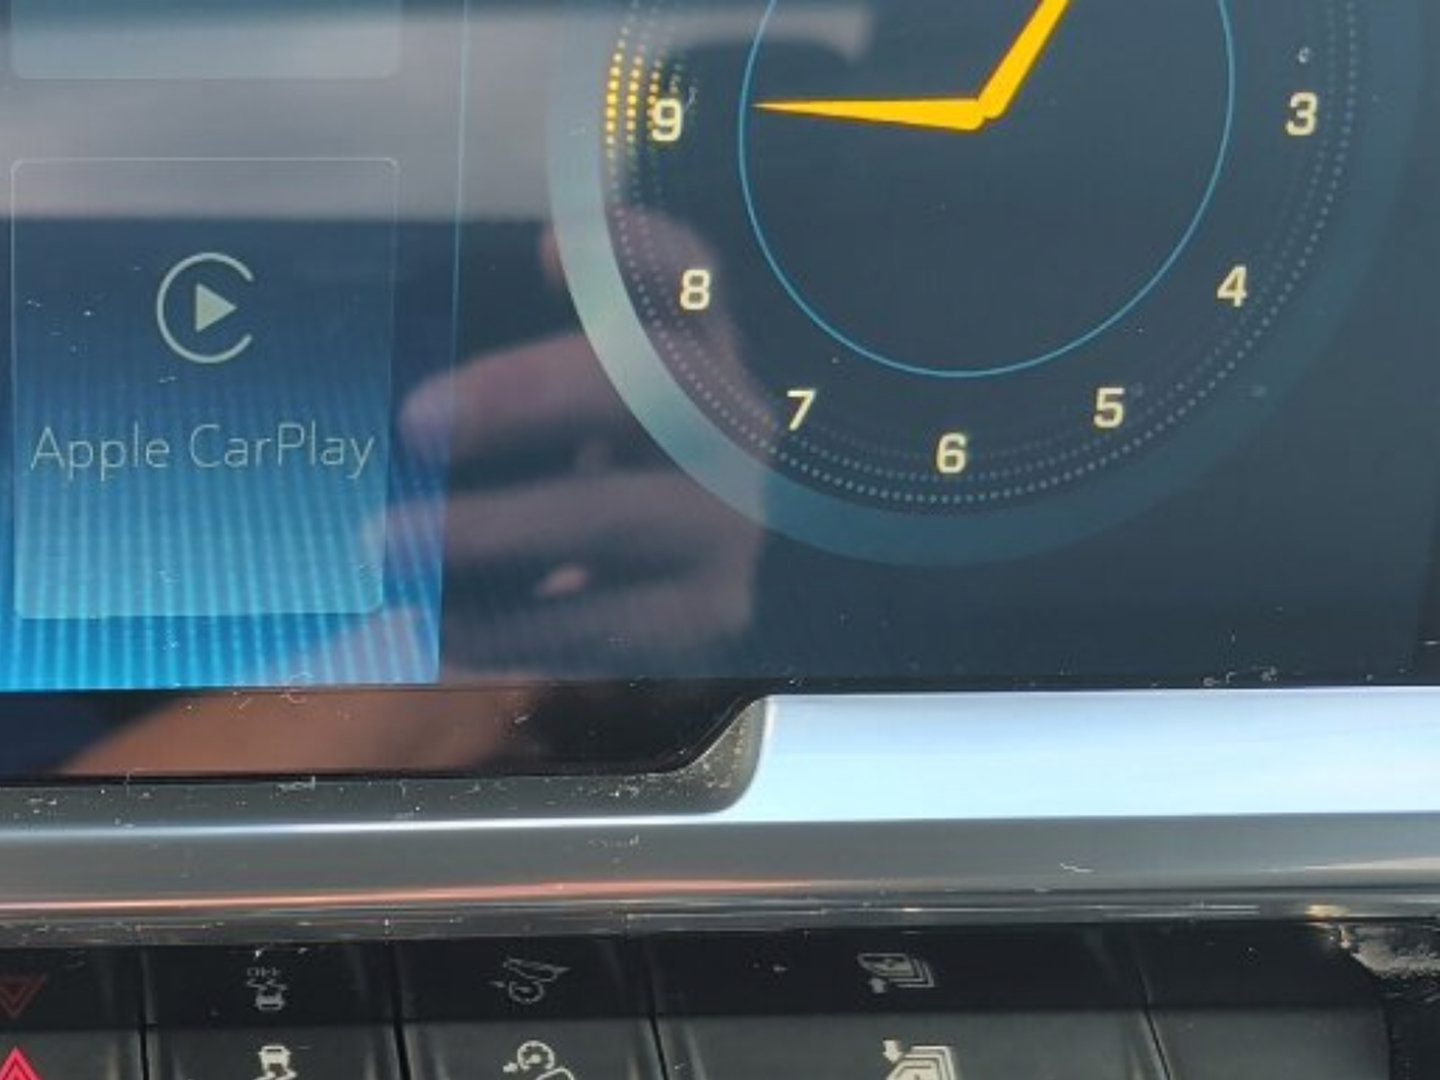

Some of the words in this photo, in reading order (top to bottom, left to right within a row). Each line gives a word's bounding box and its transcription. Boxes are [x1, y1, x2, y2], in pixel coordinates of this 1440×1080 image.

[650, 97, 683, 142] 9
[1286, 92, 1318, 138] 3
[679, 268, 711, 310] 8
[1216, 265, 1248, 308] 4
[786, 390, 816, 429] 7
[1094, 388, 1124, 428] 5
[30, 427, 171, 482] Apple
[188, 422, 375, 480] CarPlay
[935, 433, 967, 473] 6
